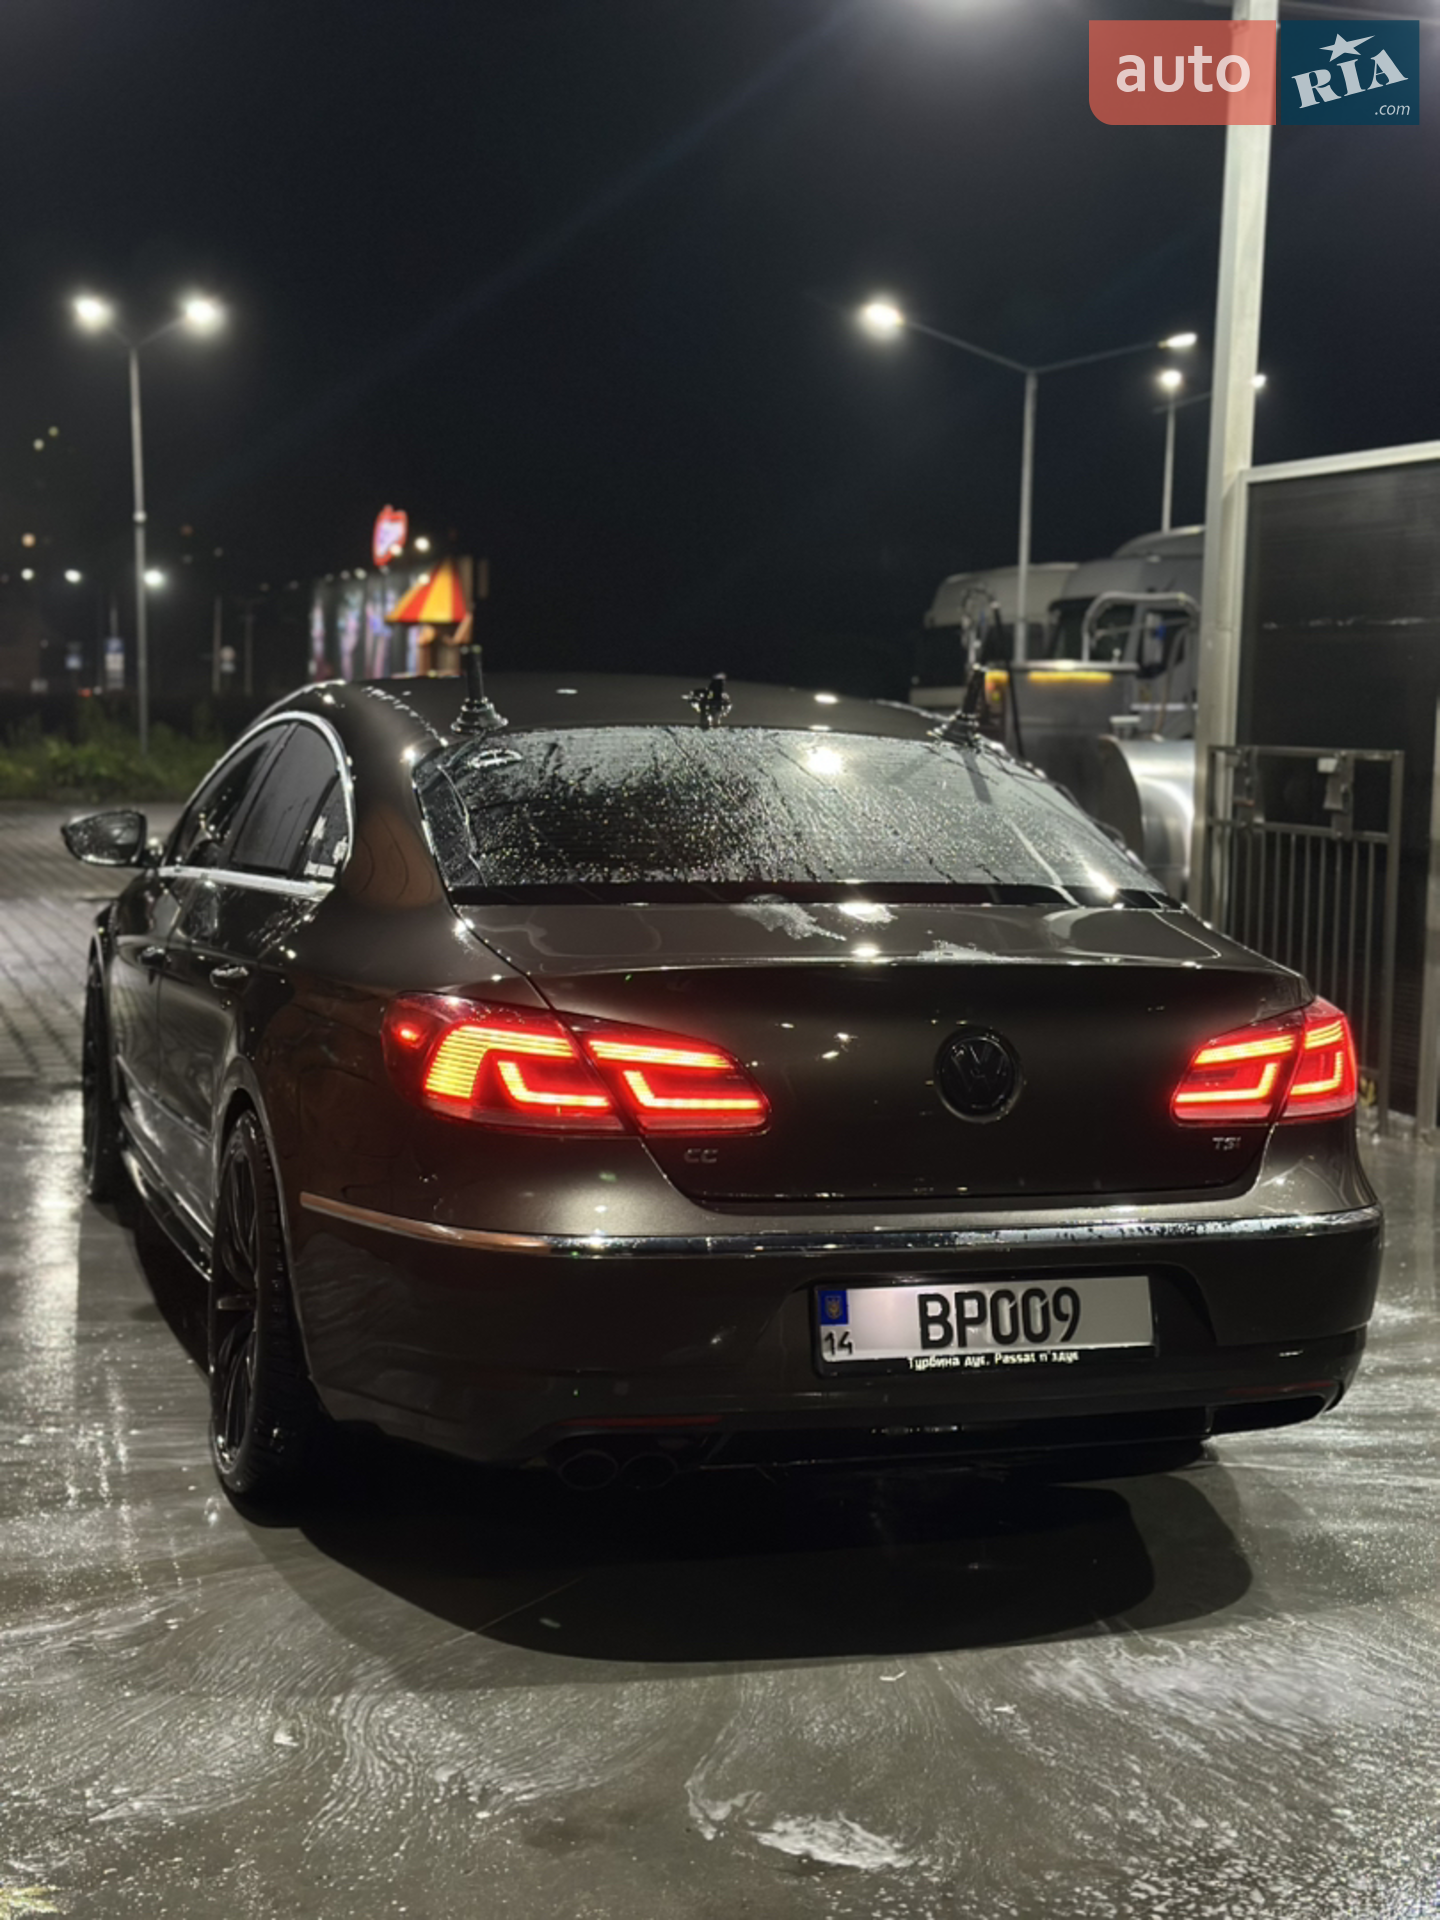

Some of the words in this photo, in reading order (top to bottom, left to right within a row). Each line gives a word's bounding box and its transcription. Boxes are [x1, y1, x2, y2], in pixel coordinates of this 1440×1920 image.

[683, 1148, 718, 1163] CC
[918, 1286, 1081, 1350] BP009
[824, 1331, 853, 1356] 14
